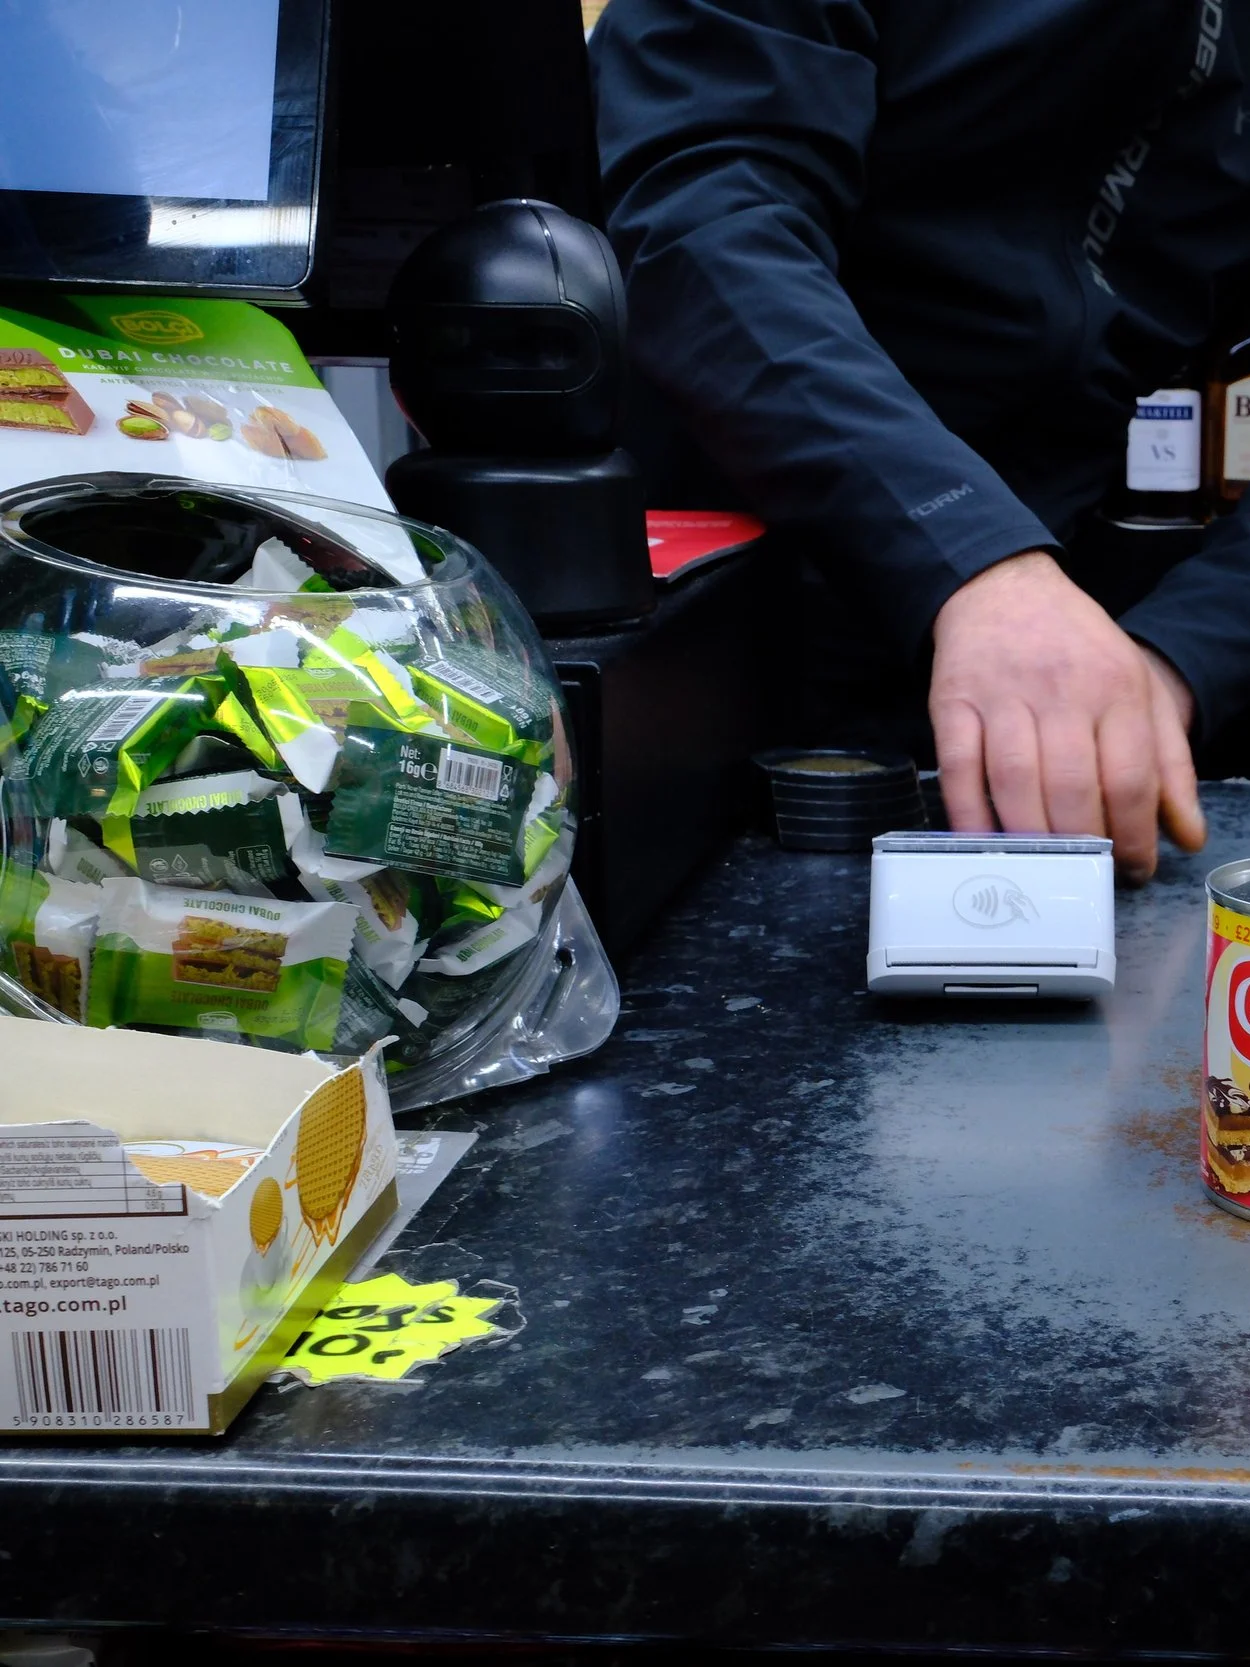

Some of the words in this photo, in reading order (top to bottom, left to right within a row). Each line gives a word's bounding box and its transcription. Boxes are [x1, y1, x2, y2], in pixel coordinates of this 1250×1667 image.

[58, 347, 142, 362] DUBAI
[151, 352, 295, 373] CHOCOLATE
[183, 897, 245, 914] CHOCOLATE
[249, 906, 281, 921] DUBAI
[16, 1230, 68, 1242] HOLDING
[71, 1231, 87, 1244] sp.
[90, 1232, 96, 1240] z
[99, 1231, 118, 1241] o.o.
[22, 1246, 56, 1258] 05-250
[58, 1246, 113, 1259] Radzymin,
[115, 1243, 190, 1256] Poland/Polsko
[20, 1261, 37, 1275] 22)
[39, 1261, 58, 1274] 786
[61, 1261, 74, 1273] 71
[76, 1260, 89, 1273] 60
[50, 1274, 160, 1292] export@tago.com.pl
